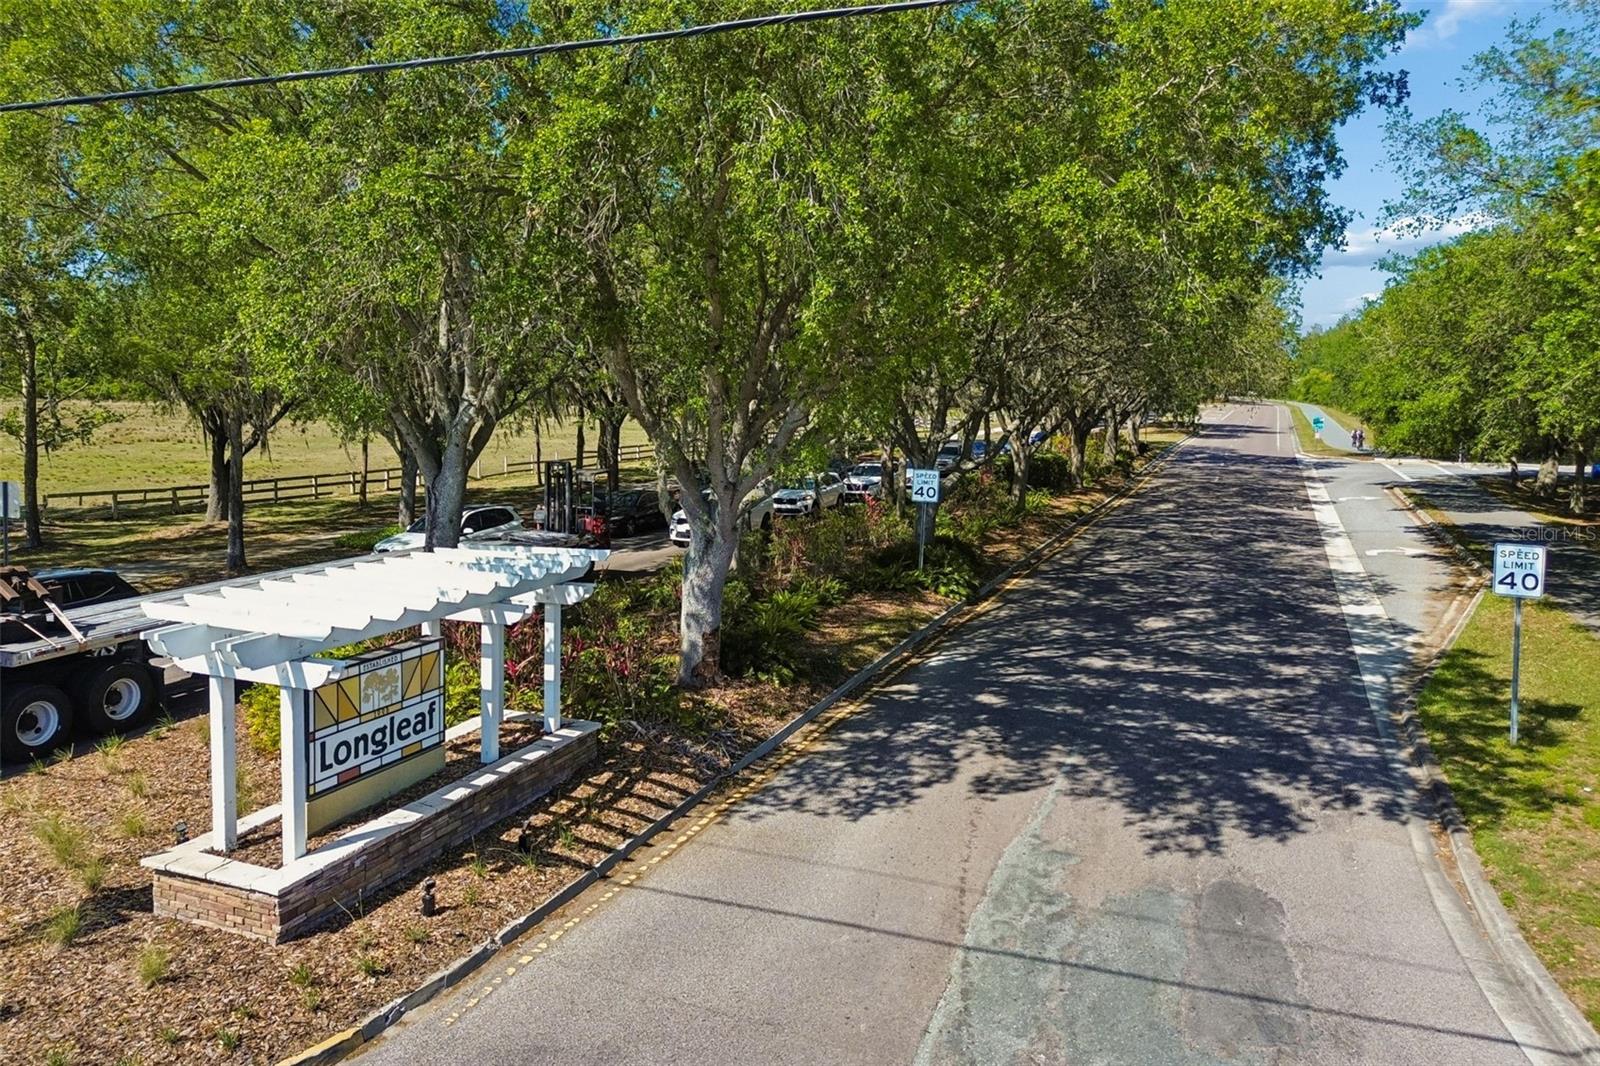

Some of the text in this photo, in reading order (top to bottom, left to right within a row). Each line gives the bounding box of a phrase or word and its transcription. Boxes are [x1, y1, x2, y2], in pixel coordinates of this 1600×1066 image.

[914, 486, 936, 498] 40
[1500, 550, 1540, 560] SPEED
[1503, 561, 1535, 570] LIMIT
[1498, 571, 1539, 591] 40
[363, 656, 399, 672] ESTABLISHED
[319, 701, 436, 772] Longleaf
